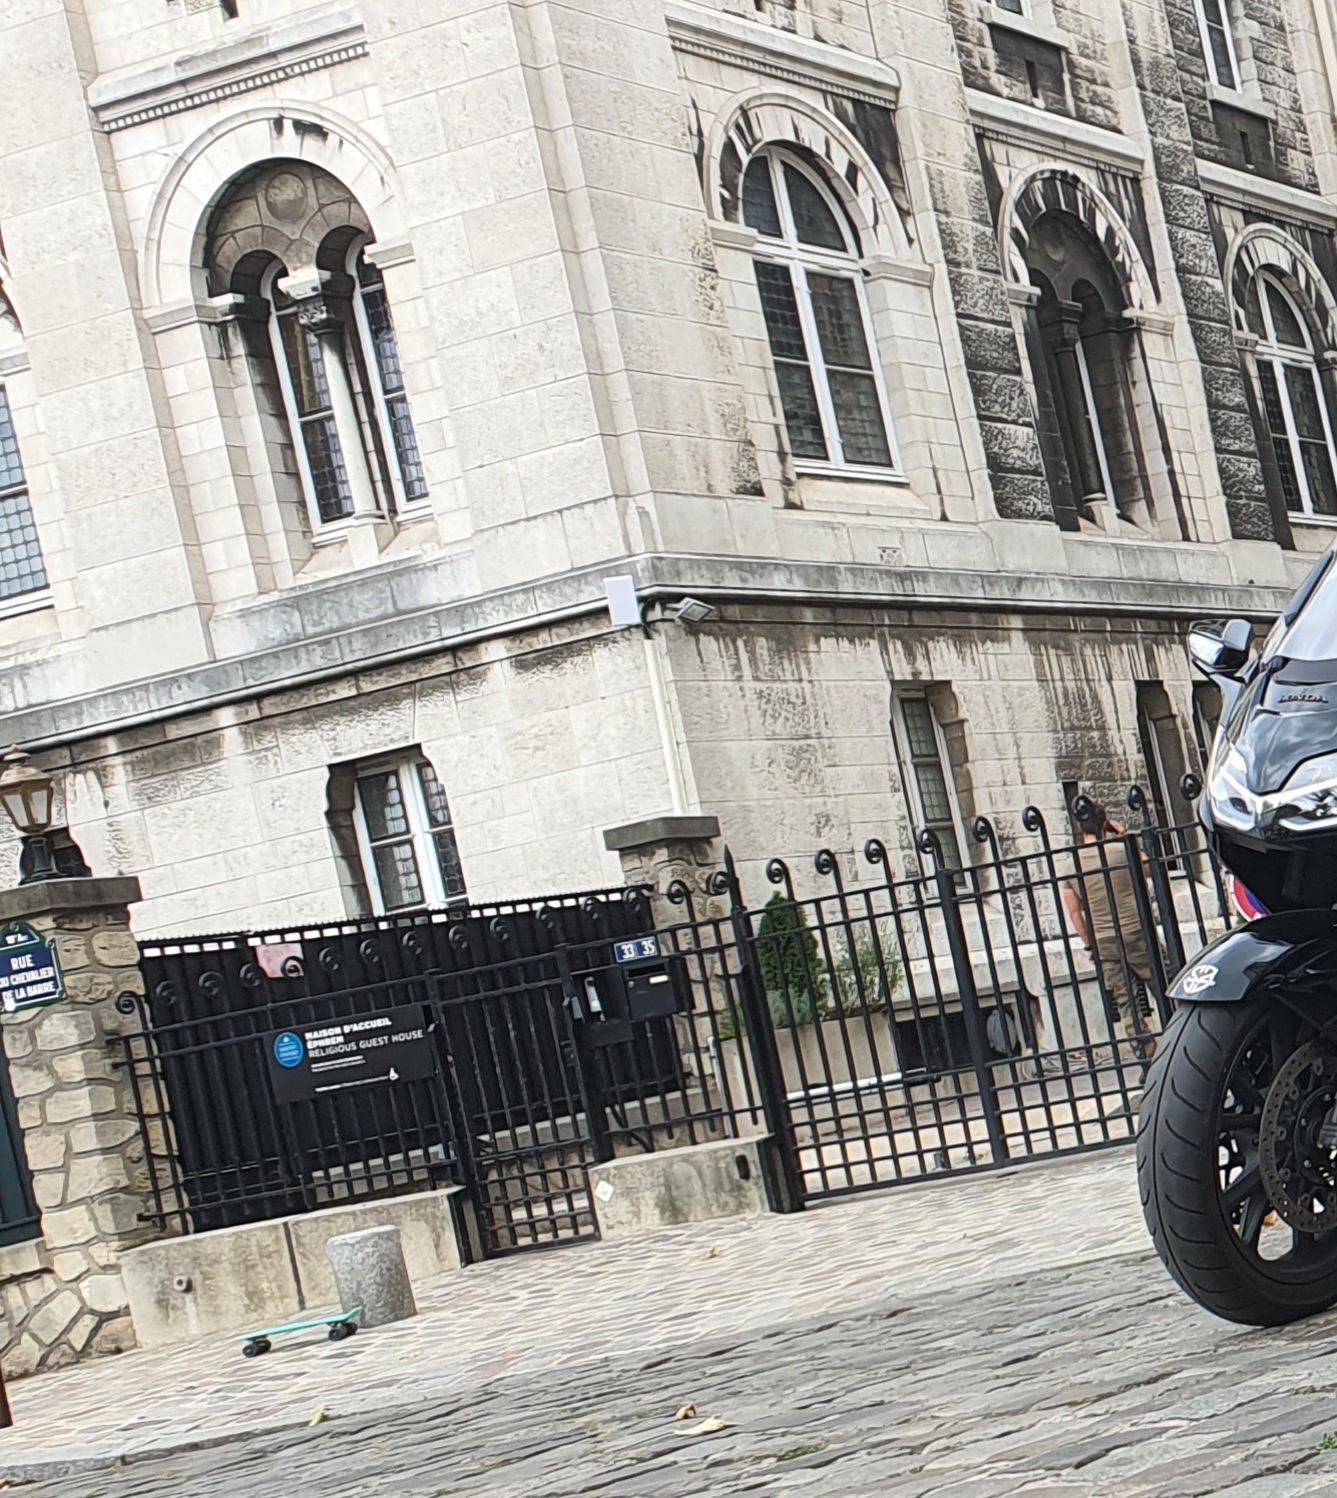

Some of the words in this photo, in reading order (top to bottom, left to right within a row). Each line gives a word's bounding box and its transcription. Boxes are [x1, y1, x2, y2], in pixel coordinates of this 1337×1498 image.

[621, 943, 635, 959] 33
[641, 939, 655, 955] 35
[10, 953, 36, 971] RUE
[10, 966, 55, 986] CHEVALIER
[15, 987, 27, 1000] LA
[26, 980, 56, 997] BARRE
[304, 1026, 342, 1040] MAISON
[343, 1017, 393, 1033] D'ACCUEIL
[306, 1035, 345, 1049] ÉPHREM
[308, 1042, 357, 1058] RELIGIOUS
[359, 1035, 390, 1049] GUEST
[391, 1029, 425, 1043] HOUSE
